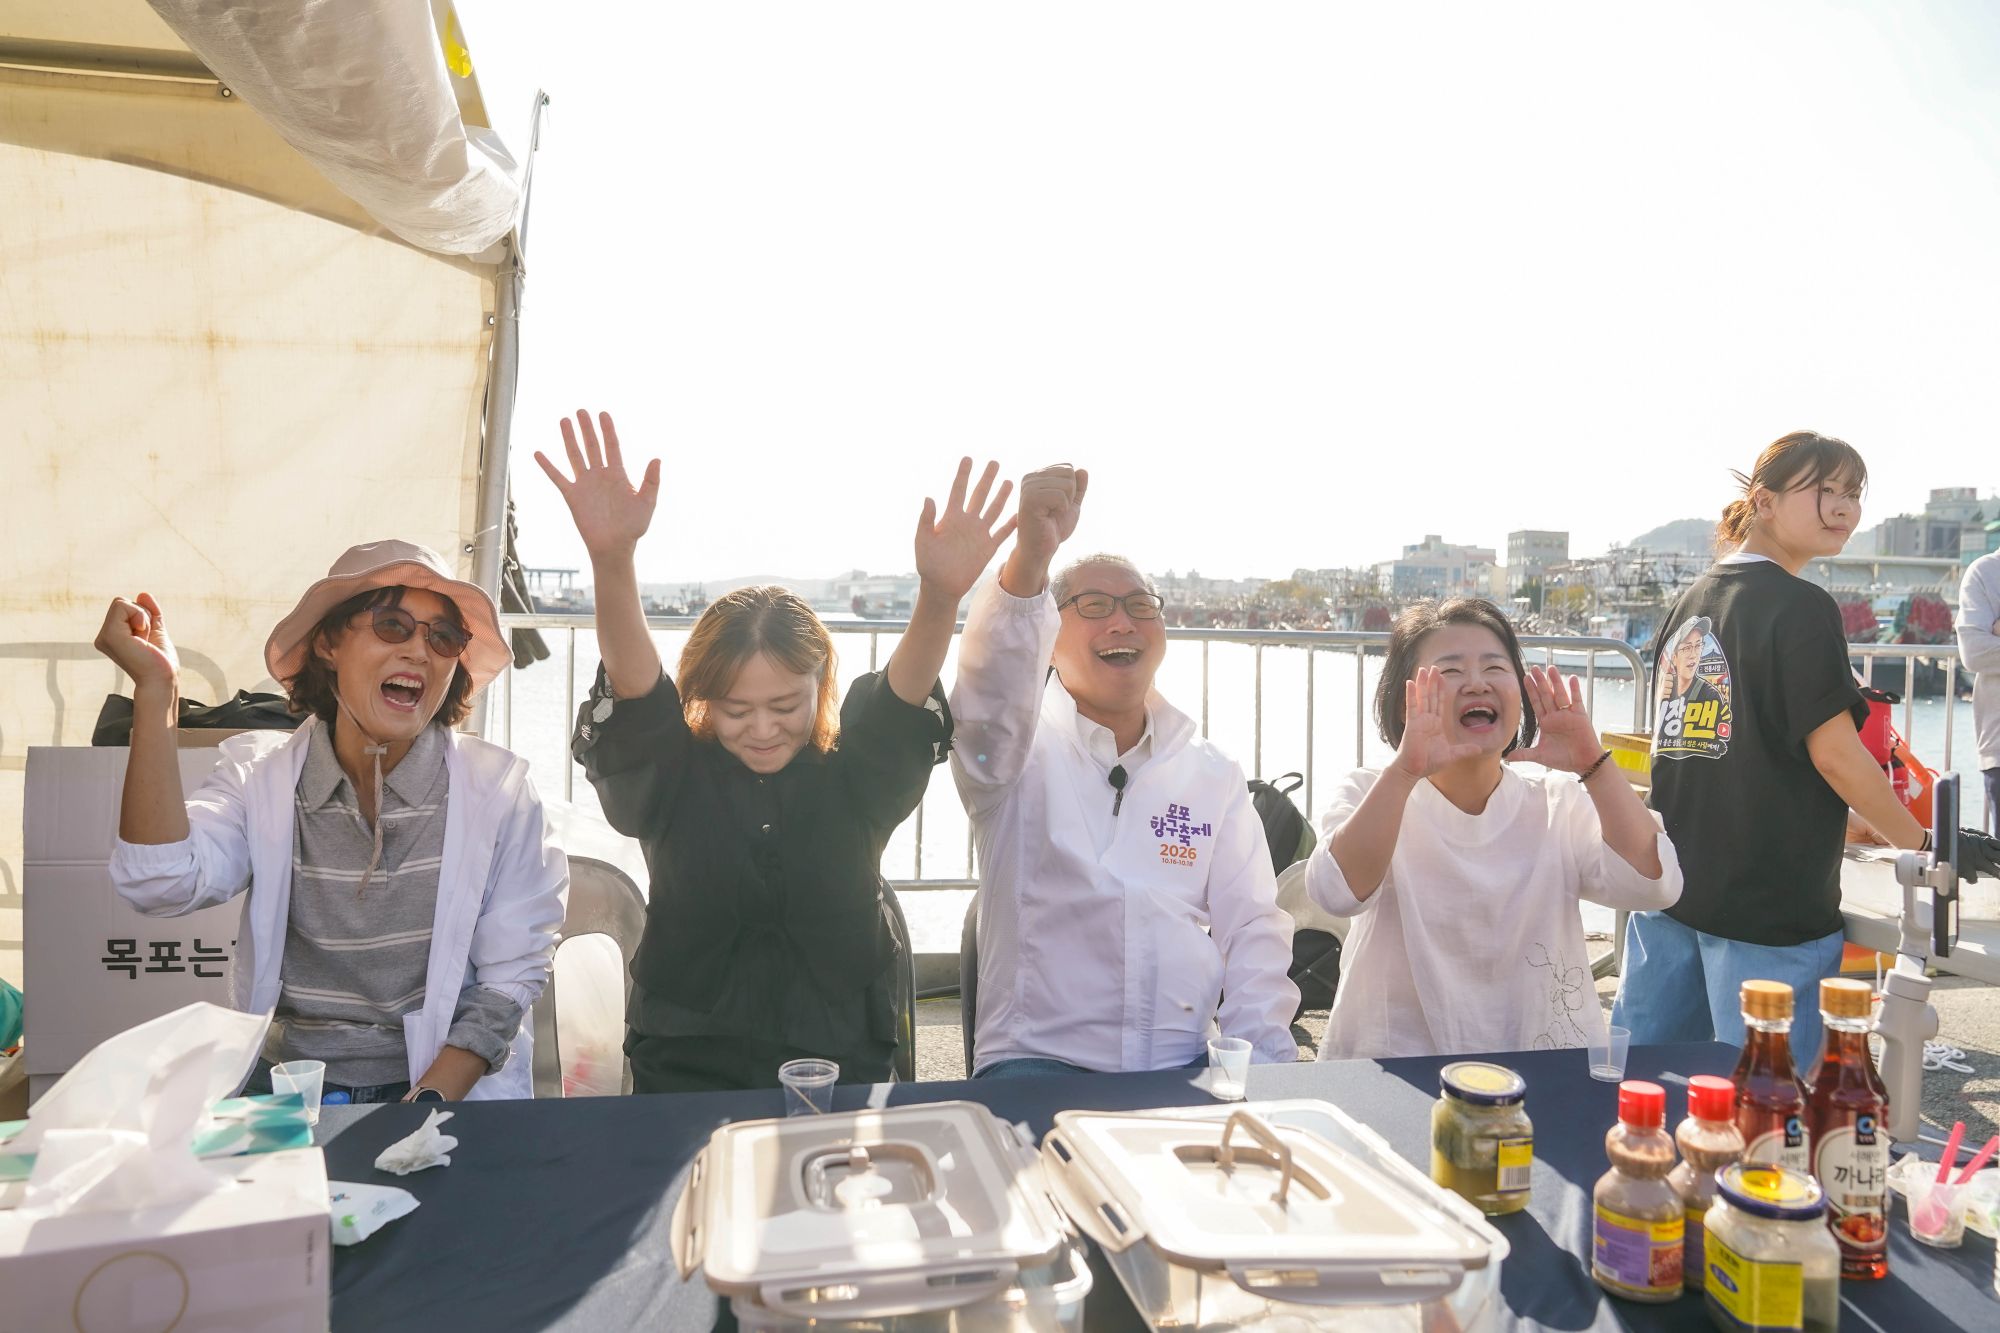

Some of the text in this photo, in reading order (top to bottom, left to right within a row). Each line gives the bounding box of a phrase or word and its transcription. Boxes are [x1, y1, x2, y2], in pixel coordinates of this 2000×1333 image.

[1150, 816, 1211, 846] 항구축제
[1160, 843, 1197, 859] 2026
[102, 938, 236, 980] 목포는
